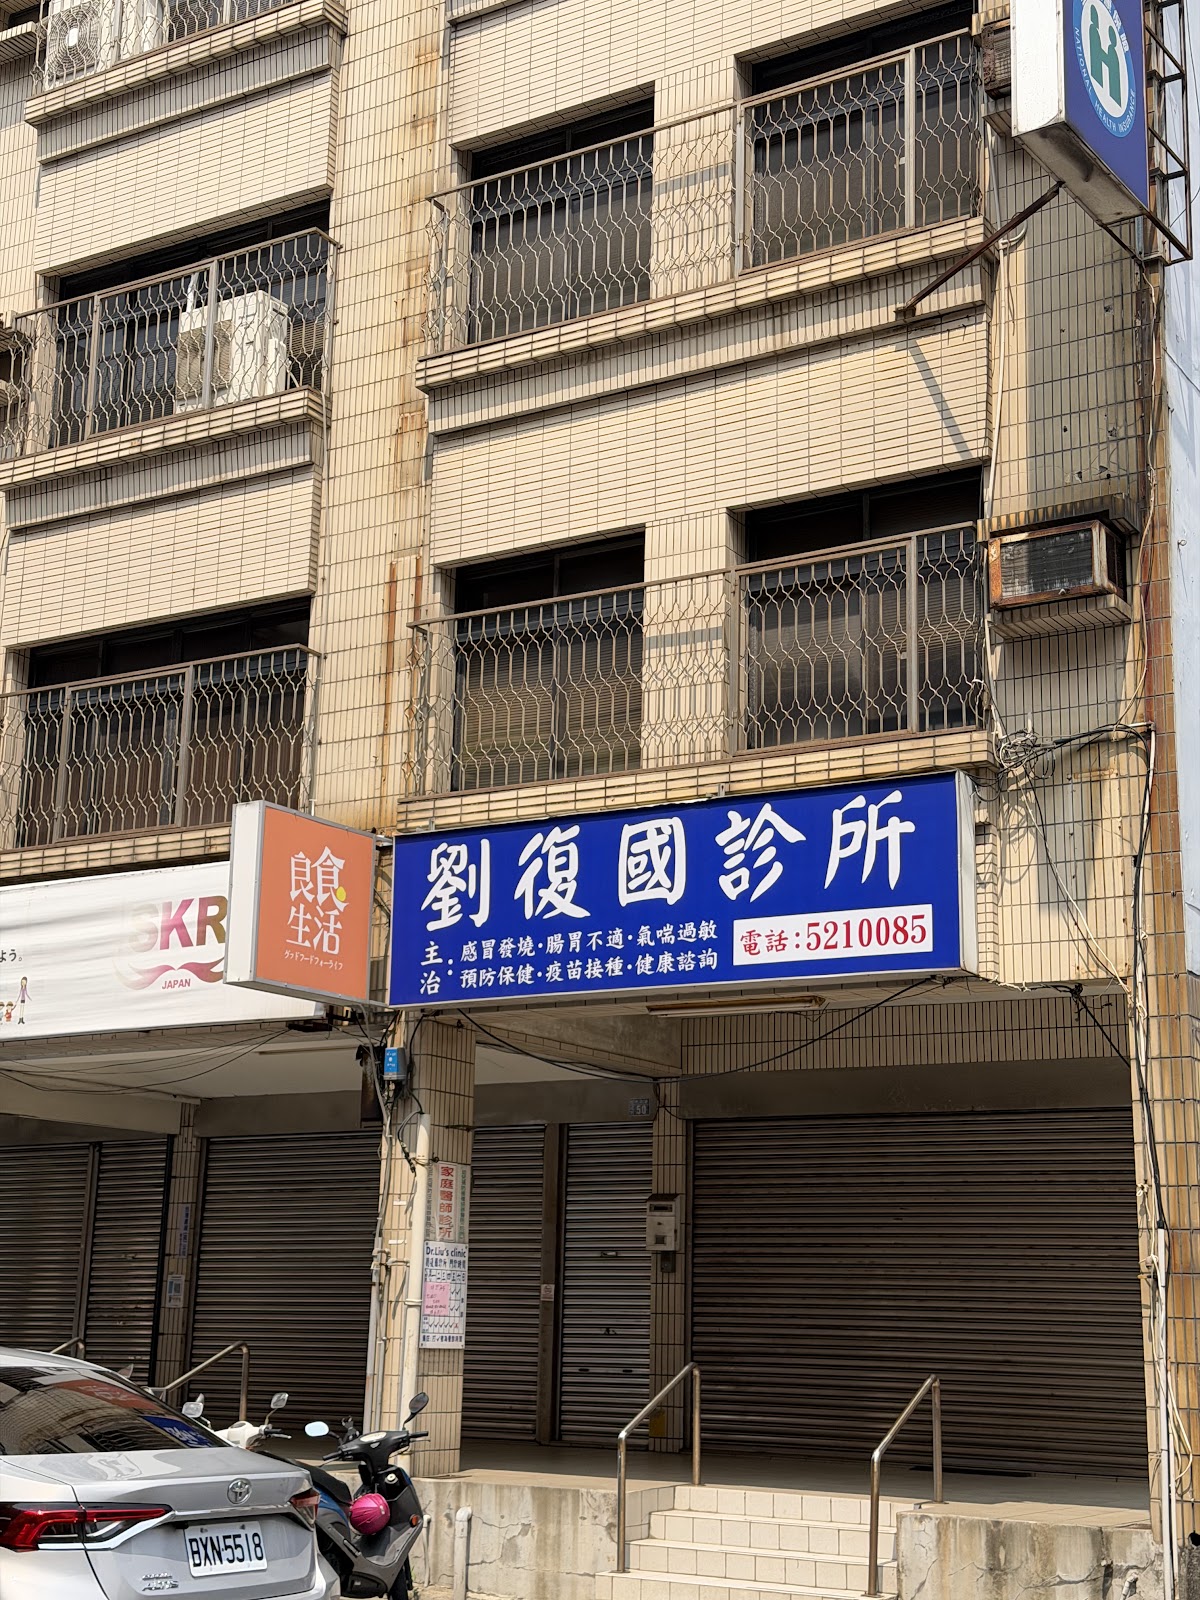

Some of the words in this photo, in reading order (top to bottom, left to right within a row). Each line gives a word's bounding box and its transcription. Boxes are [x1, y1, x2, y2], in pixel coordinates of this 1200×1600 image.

[1074, 26, 1094, 96] NATIONAL
[1094, 100, 1117, 132] HEALTH
[1118, 88, 1136, 133] INSURANCE
[289, 845, 349, 913] 良食
[421, 789, 916, 932] 劉復國診所
[285, 902, 343, 955] 生活
[161, 978, 191, 990] JAPAN
[635, 1104, 647, 1115] 50
[437, 1166, 454, 1239] 家庭醫師診所
[450, 1248, 467, 1258] clinic
[188, 1532, 265, 1568] BXN-5518
